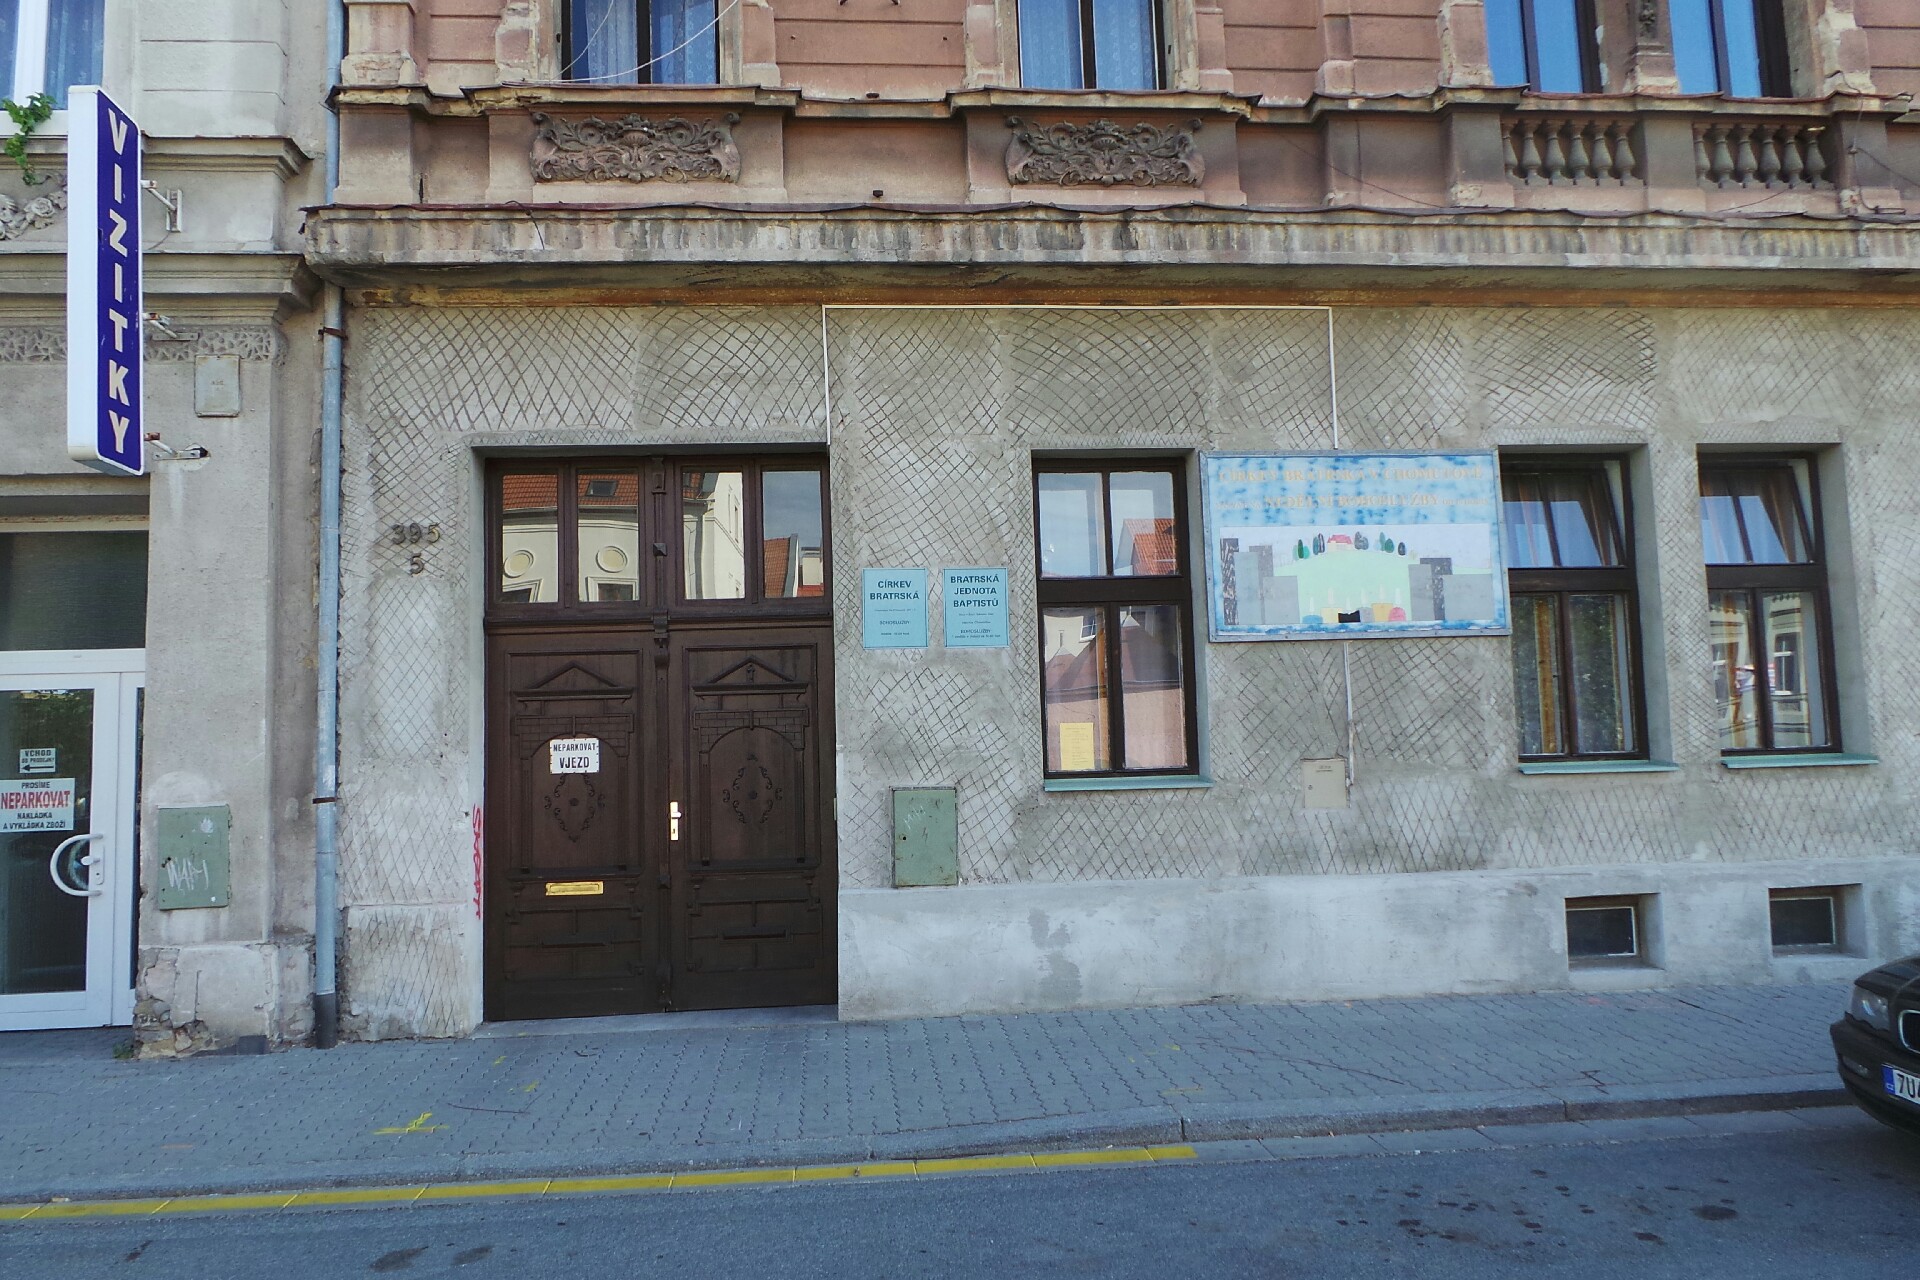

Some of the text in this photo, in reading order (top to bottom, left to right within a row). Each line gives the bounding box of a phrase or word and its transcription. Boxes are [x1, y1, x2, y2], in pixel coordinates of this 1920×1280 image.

[108, 107, 130, 454] VIZITKY
[391, 522, 440, 545] 395
[409, 552, 425, 574] 5
[950, 573, 1000, 583] BRATRSKÁ
[878, 579, 912, 588] CÍRKEV
[870, 590, 920, 600] BRATRSKÁ
[954, 587, 997, 595] JEDNOTA
[553, 743, 597, 752] NEPARKOVAT
[559, 756, 590, 769] VJEZD
[21, 781, 51, 789] PROSÍME
[0, 790, 71, 810] NEPARKOVAT
[3, 822, 8, 830] A
